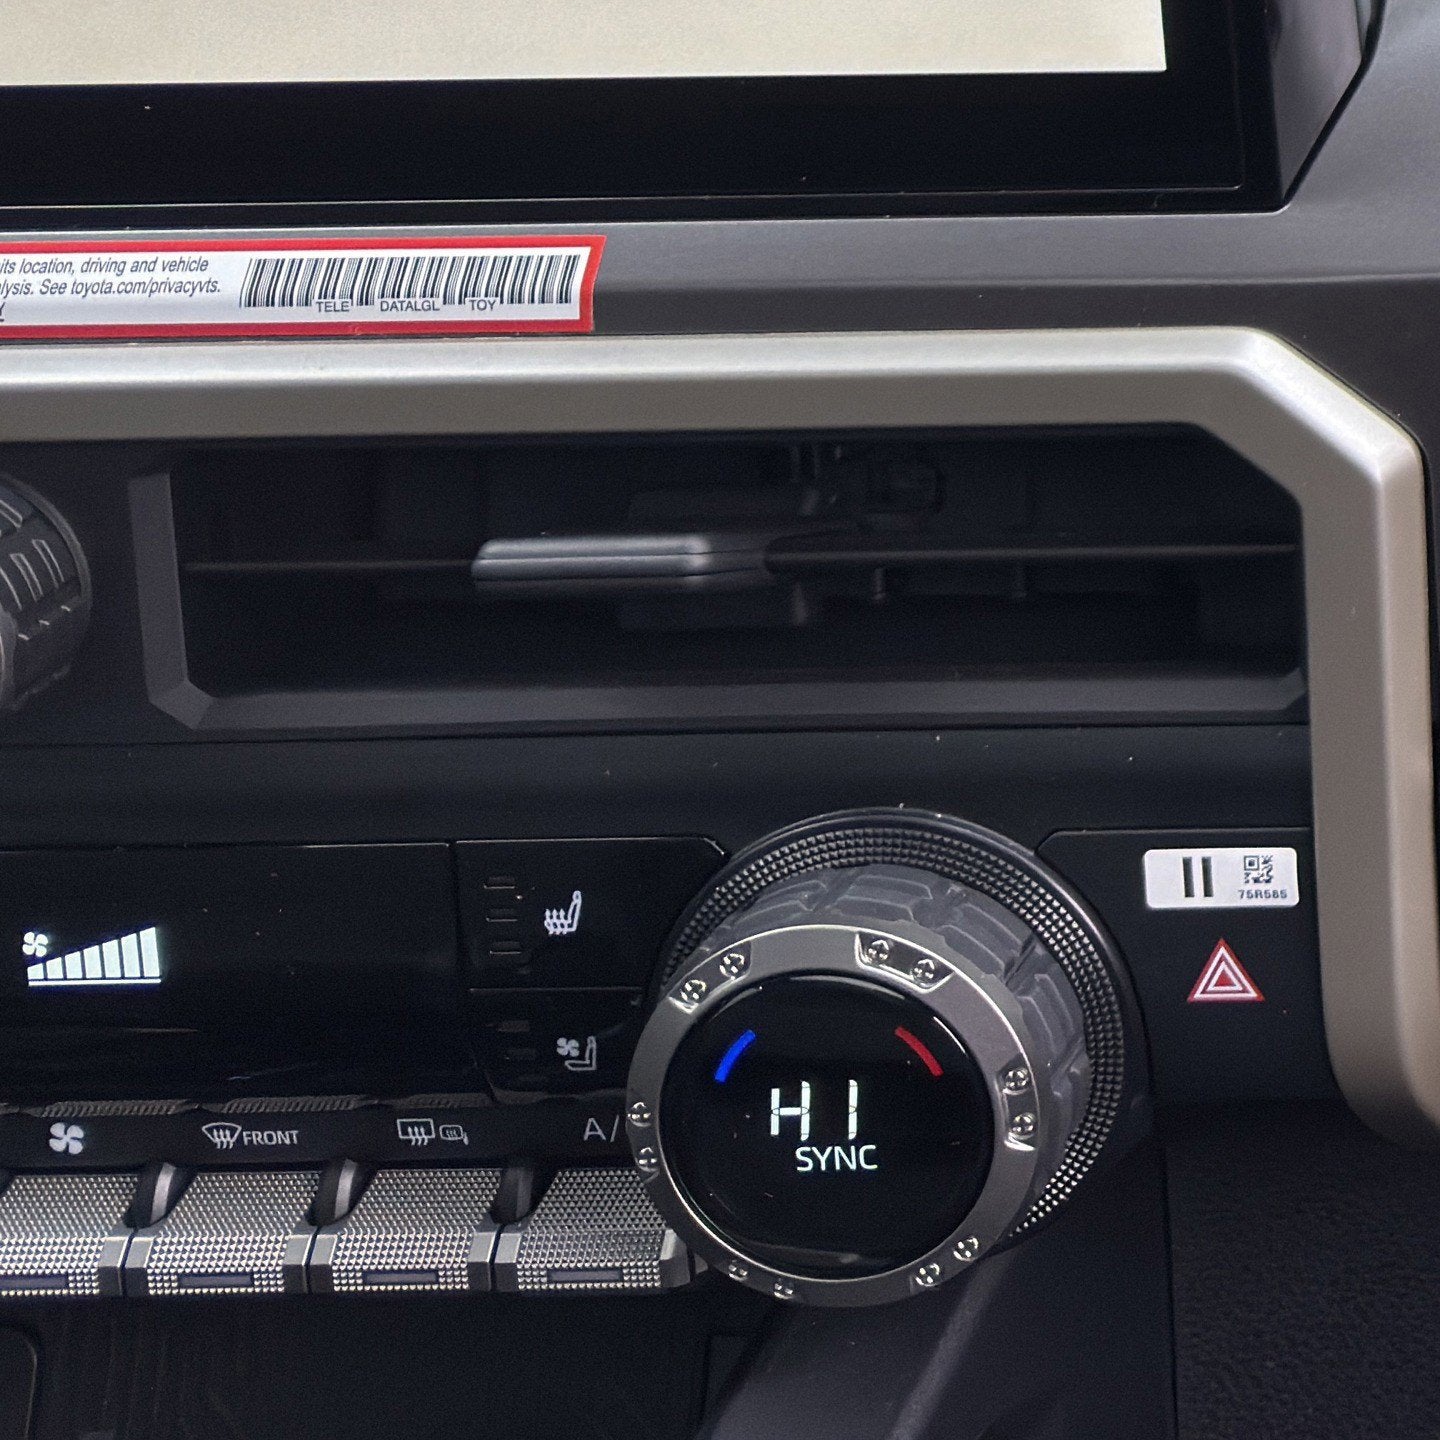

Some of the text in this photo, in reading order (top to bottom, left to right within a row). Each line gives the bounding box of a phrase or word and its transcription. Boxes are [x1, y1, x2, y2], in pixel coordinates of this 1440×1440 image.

[19, 258, 75, 276] location,
[80, 257, 126, 277] driving
[130, 257, 158, 273] and
[162, 256, 209, 272] vehicle
[0, 278, 221, 299] lysis. See toyota.com/privacyvts.
[315, 298, 496, 313] TELE DATALGL TOY
[243, 1130, 298, 1146] FRONT
[795, 1144, 878, 1171] SYNC
